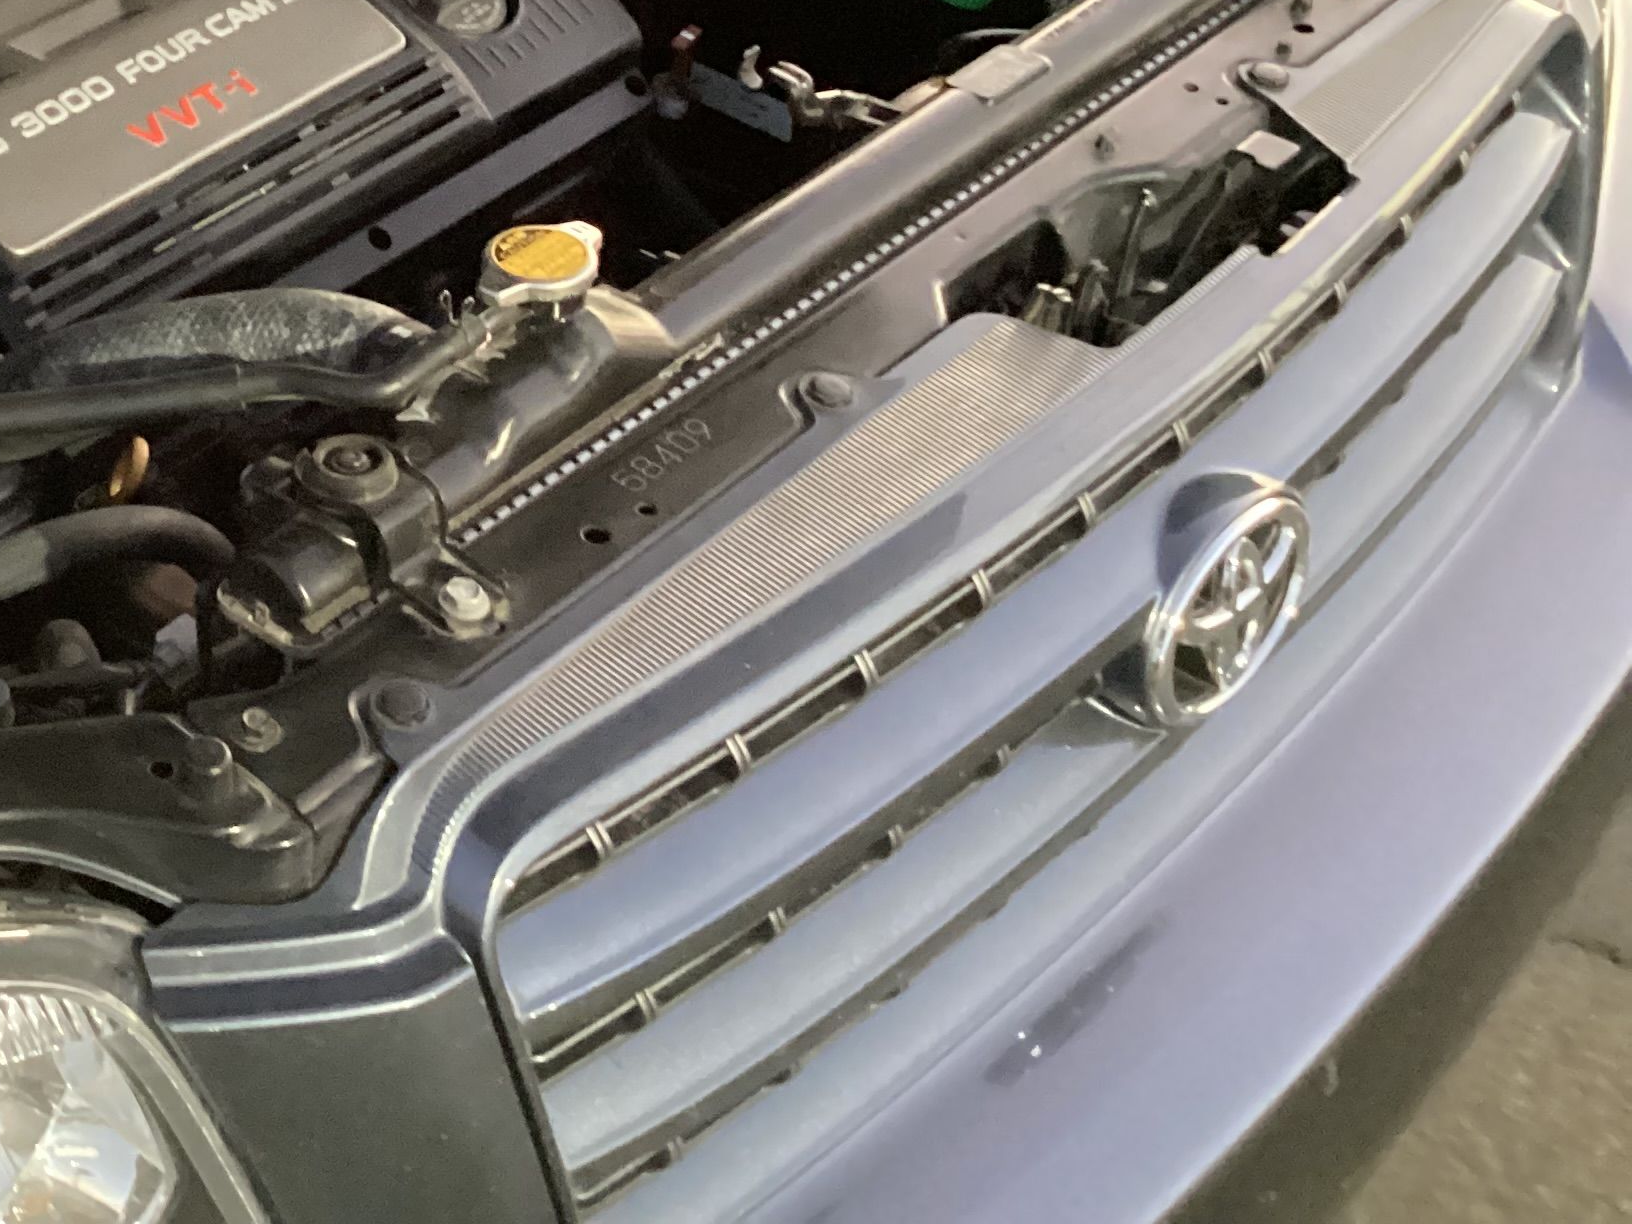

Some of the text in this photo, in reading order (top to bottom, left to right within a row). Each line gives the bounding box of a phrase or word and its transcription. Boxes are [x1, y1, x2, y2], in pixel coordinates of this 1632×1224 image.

[10, 76, 116, 138] 3000
[115, 28, 211, 84] FOUR
[125, 68, 259, 148] VVT-i
[609, 417, 712, 492] 58409
